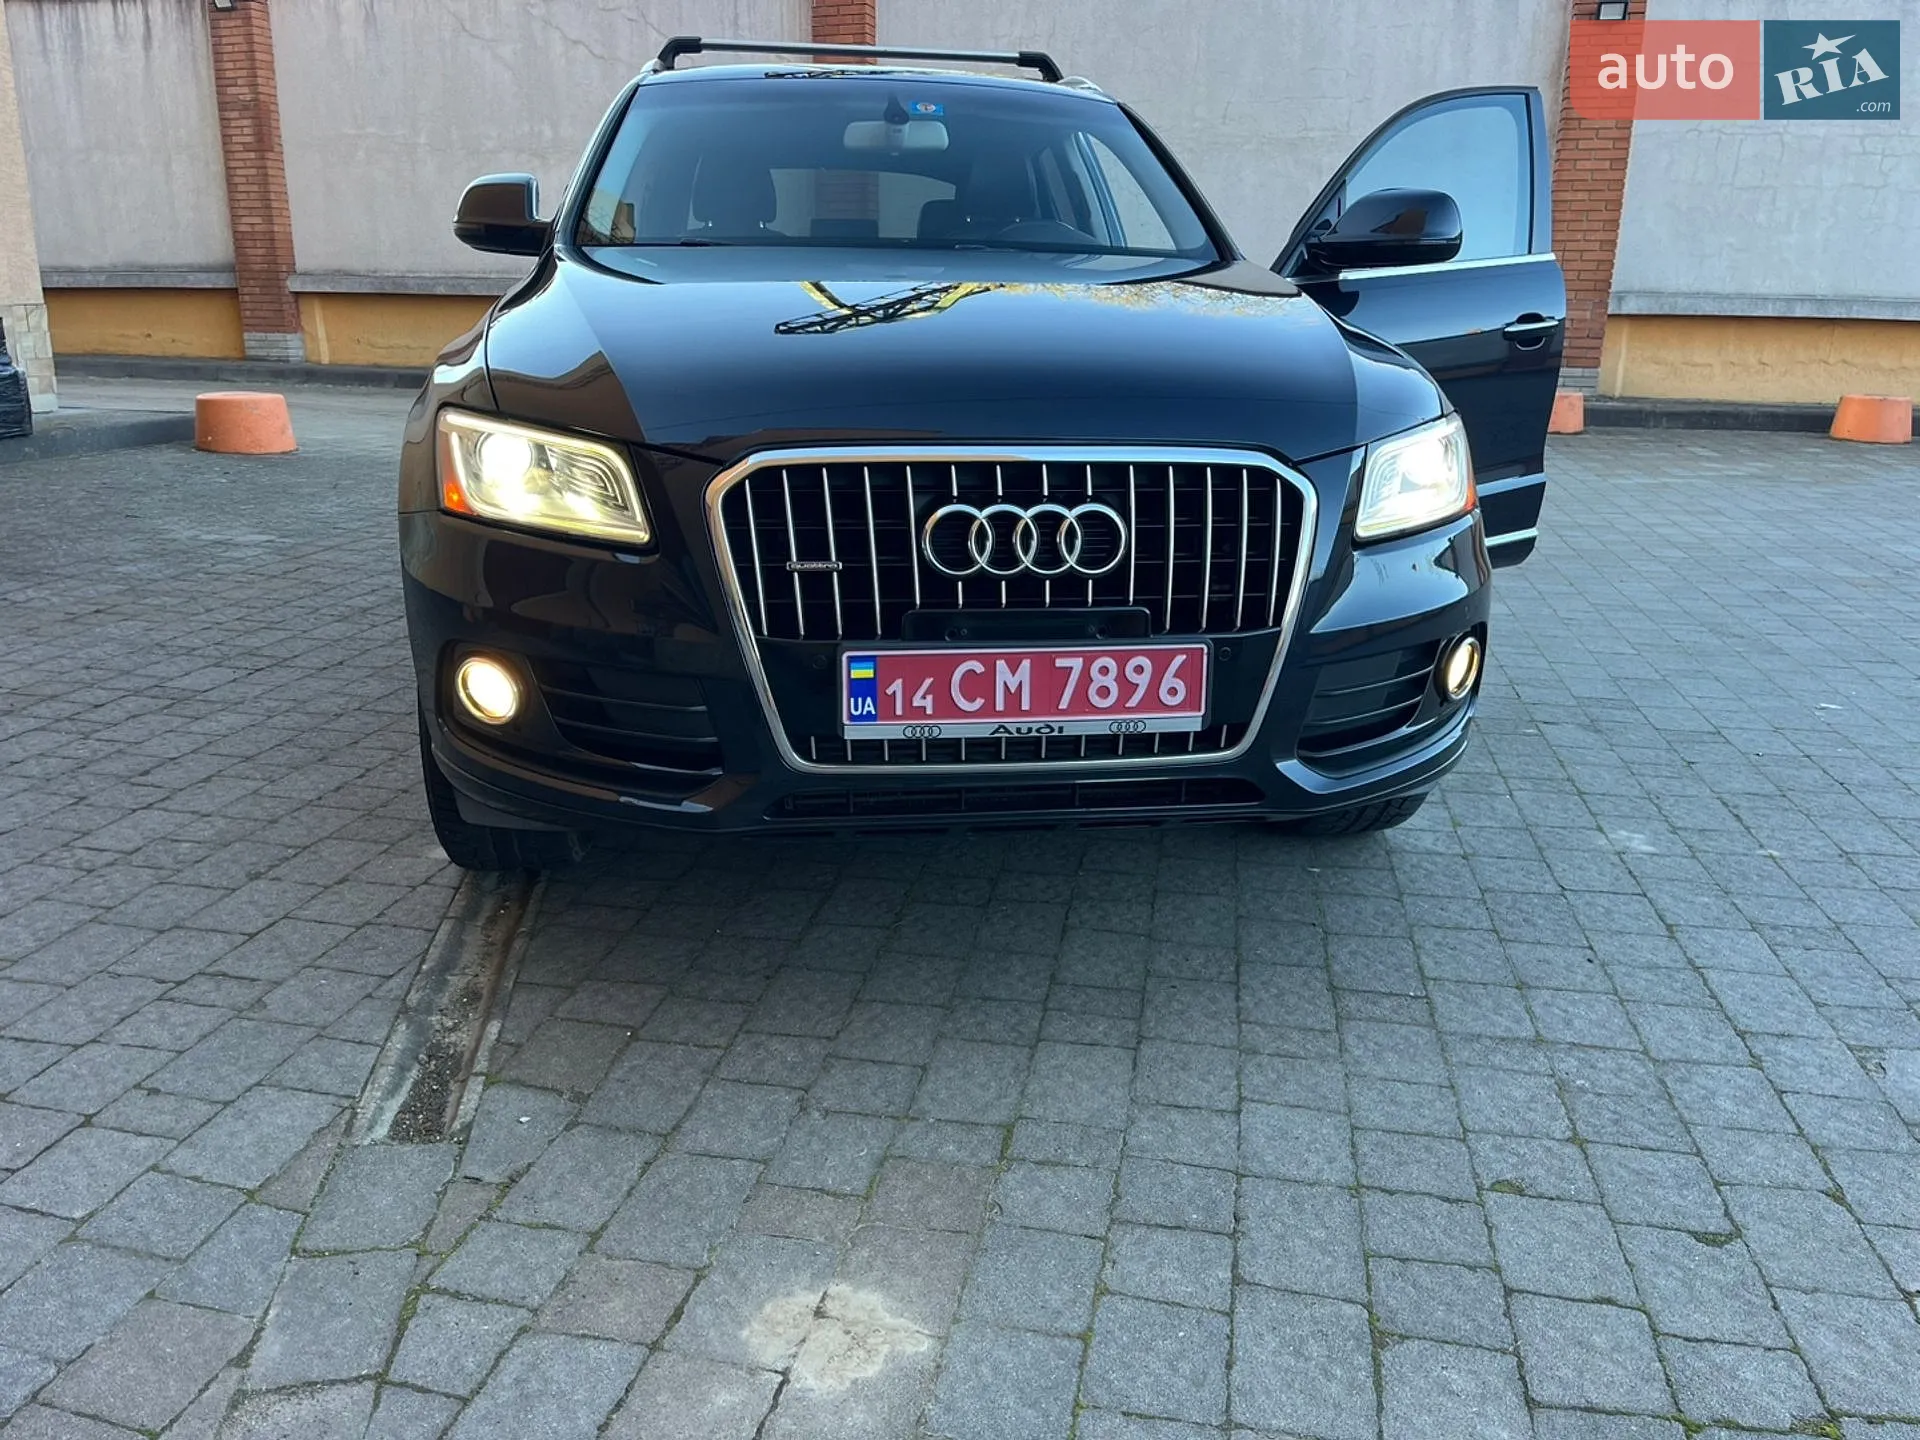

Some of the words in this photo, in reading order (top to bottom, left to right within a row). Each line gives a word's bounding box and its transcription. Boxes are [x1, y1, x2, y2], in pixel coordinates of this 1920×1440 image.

[884, 678, 934, 716] 14
[950, 658, 1031, 713] CM
[1054, 654, 1187, 710] 7896
[850, 697, 875, 716] UA
[989, 724, 1064, 735] Audi
